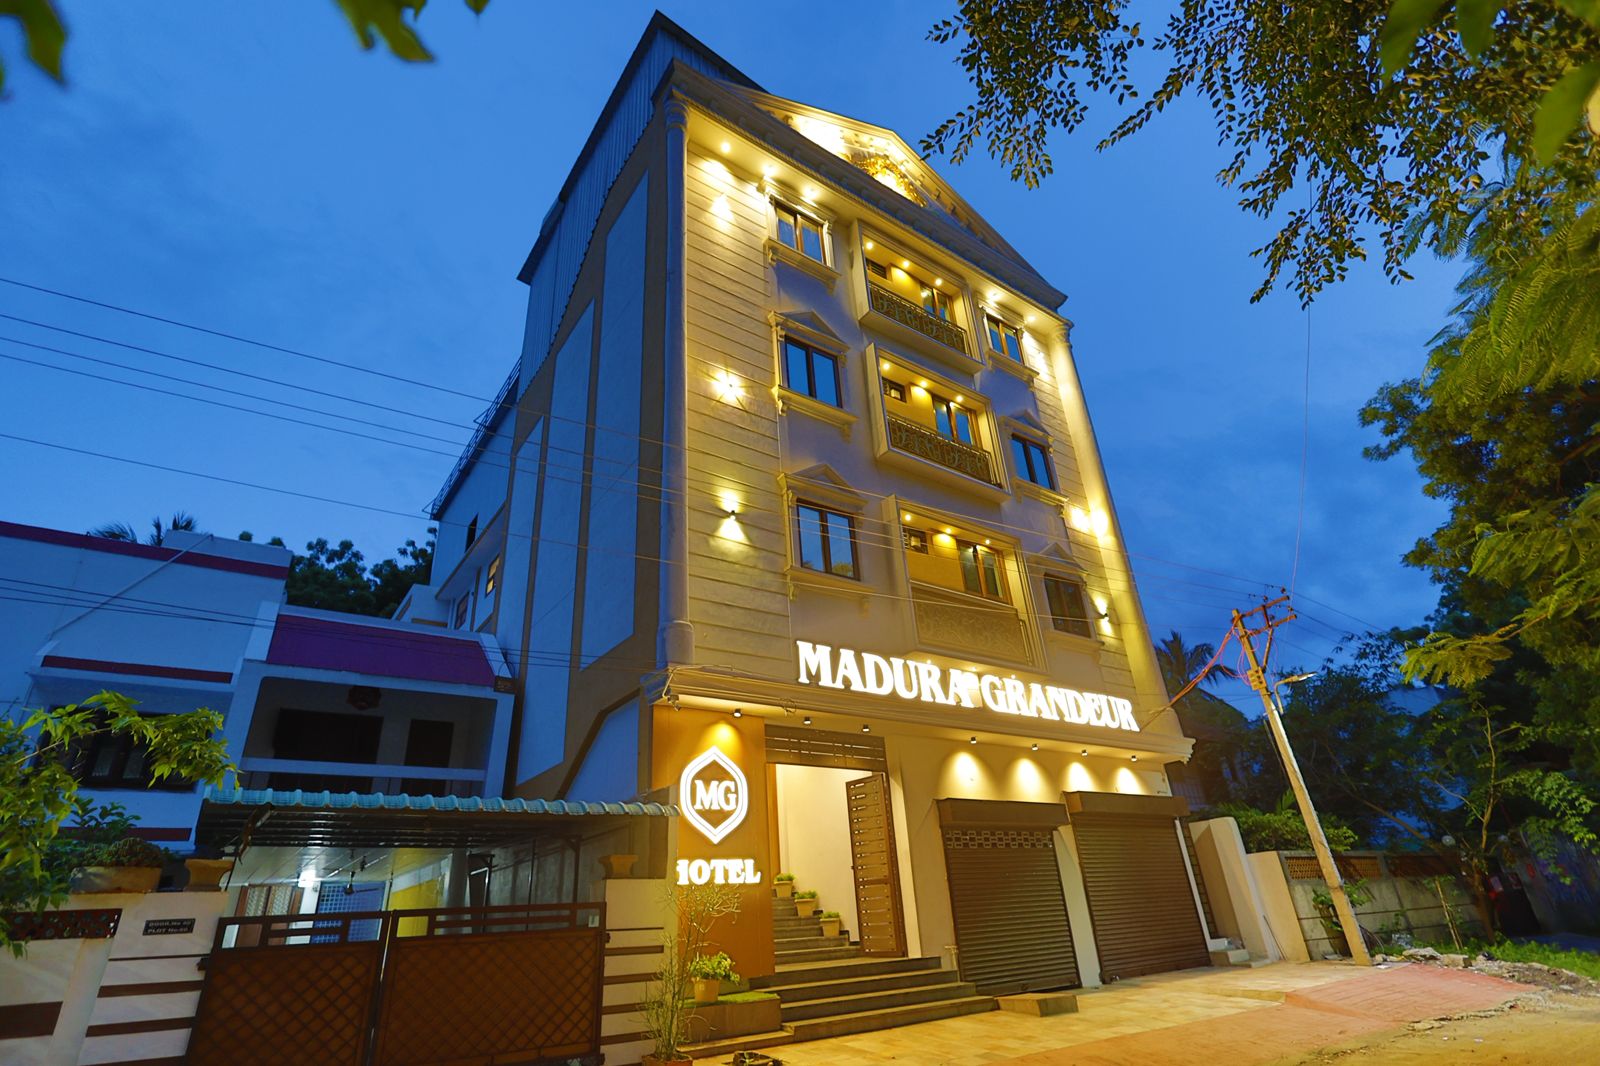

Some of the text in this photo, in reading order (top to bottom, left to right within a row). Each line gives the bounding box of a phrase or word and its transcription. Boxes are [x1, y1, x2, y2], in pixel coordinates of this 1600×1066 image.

[796, 640, 1141, 732] MADURA GRANDEUR
[693, 779, 737, 811] MG
